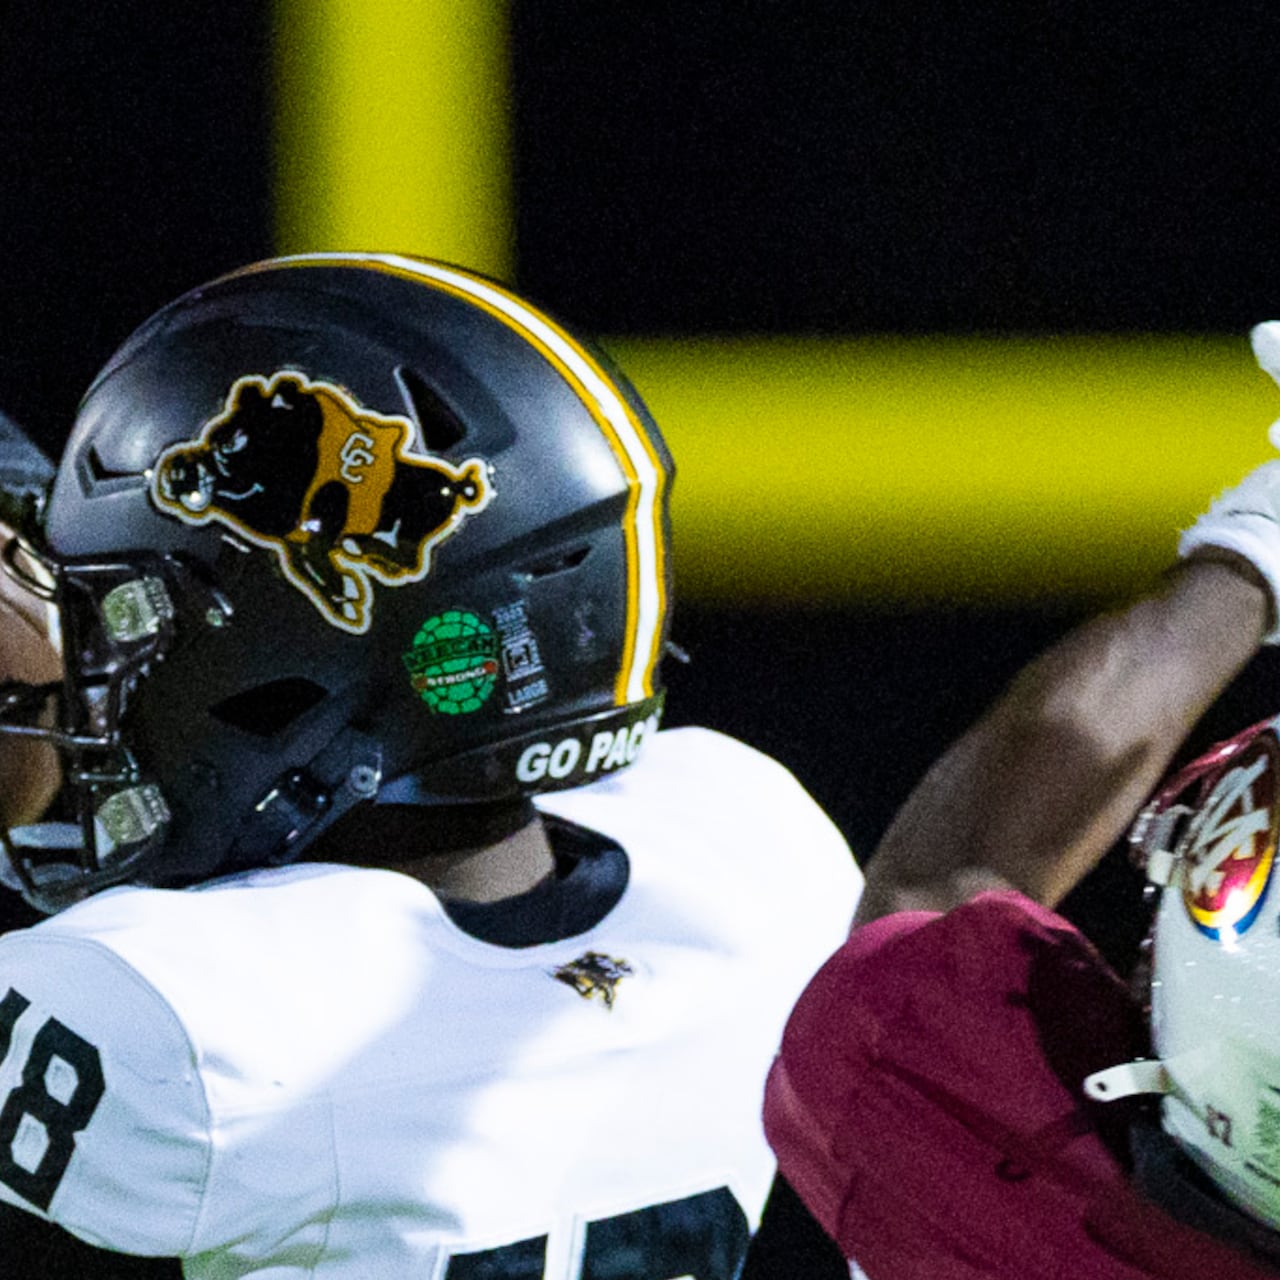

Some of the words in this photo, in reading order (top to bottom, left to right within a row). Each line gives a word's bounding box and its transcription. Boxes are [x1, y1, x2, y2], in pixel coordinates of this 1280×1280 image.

[340, 432, 374, 482] CC
[507, 679, 549, 706] LARGE
[516, 738, 581, 782] GO
